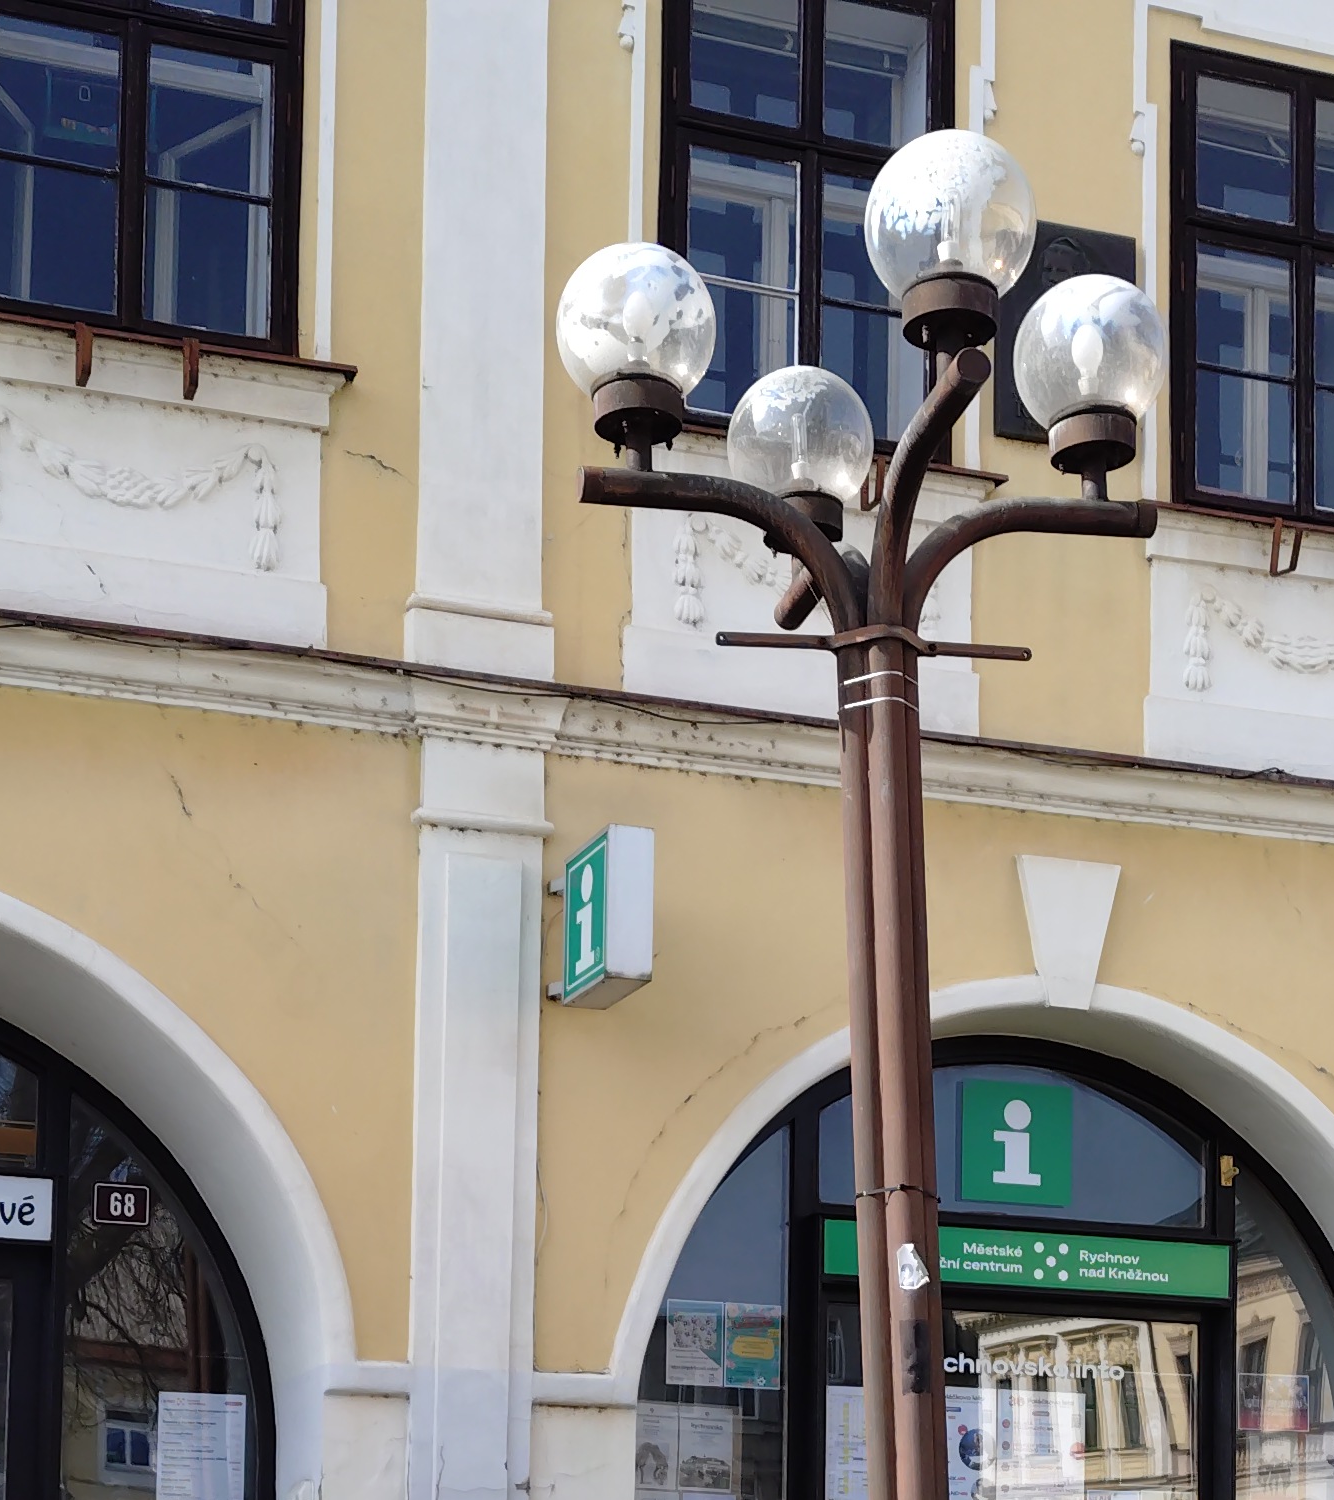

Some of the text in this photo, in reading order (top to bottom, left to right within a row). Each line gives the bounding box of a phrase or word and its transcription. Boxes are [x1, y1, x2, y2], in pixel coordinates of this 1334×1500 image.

[109, 1192, 135, 1217] 68
[963, 1242, 1023, 1258] Městské
[1079, 1250, 1140, 1266] Rychnov
[963, 1261, 1023, 1274] centrum
[1079, 1266, 1169, 1283] nad Kněžnou
[943, 1352, 1125, 1380] chnovsko.info
